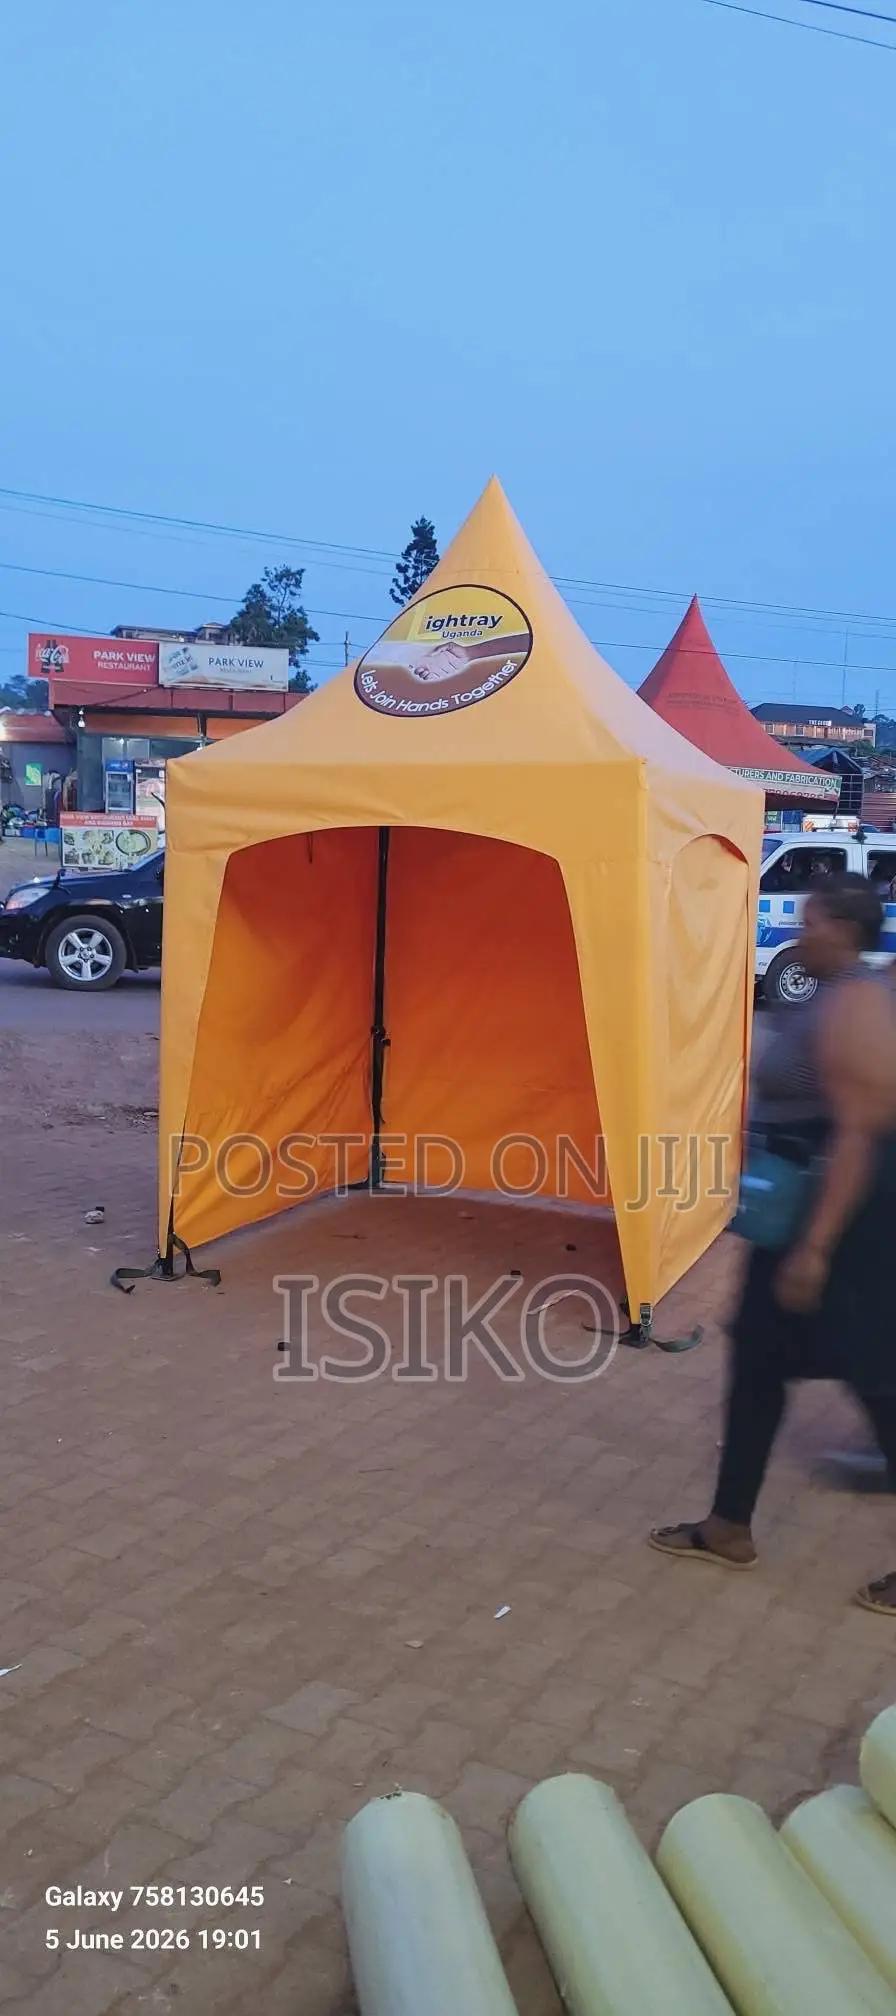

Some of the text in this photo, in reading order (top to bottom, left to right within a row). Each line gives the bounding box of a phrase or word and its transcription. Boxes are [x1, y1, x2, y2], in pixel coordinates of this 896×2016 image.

[425, 614, 503, 632] ightray
[442, 630, 483, 639] Uganda
[93, 649, 125, 661] PARK
[126, 652, 157, 664] VIEW
[208, 657, 264, 669] PARK VIEW
[97, 660, 151, 671] RESTAURANT
[371, 691, 397, 709] Join
[397, 699, 449, 712] Hands
[451, 660, 518, 705] Together
[765, 771, 785, 782] AND
[785, 774, 837, 789] FABRICATION
